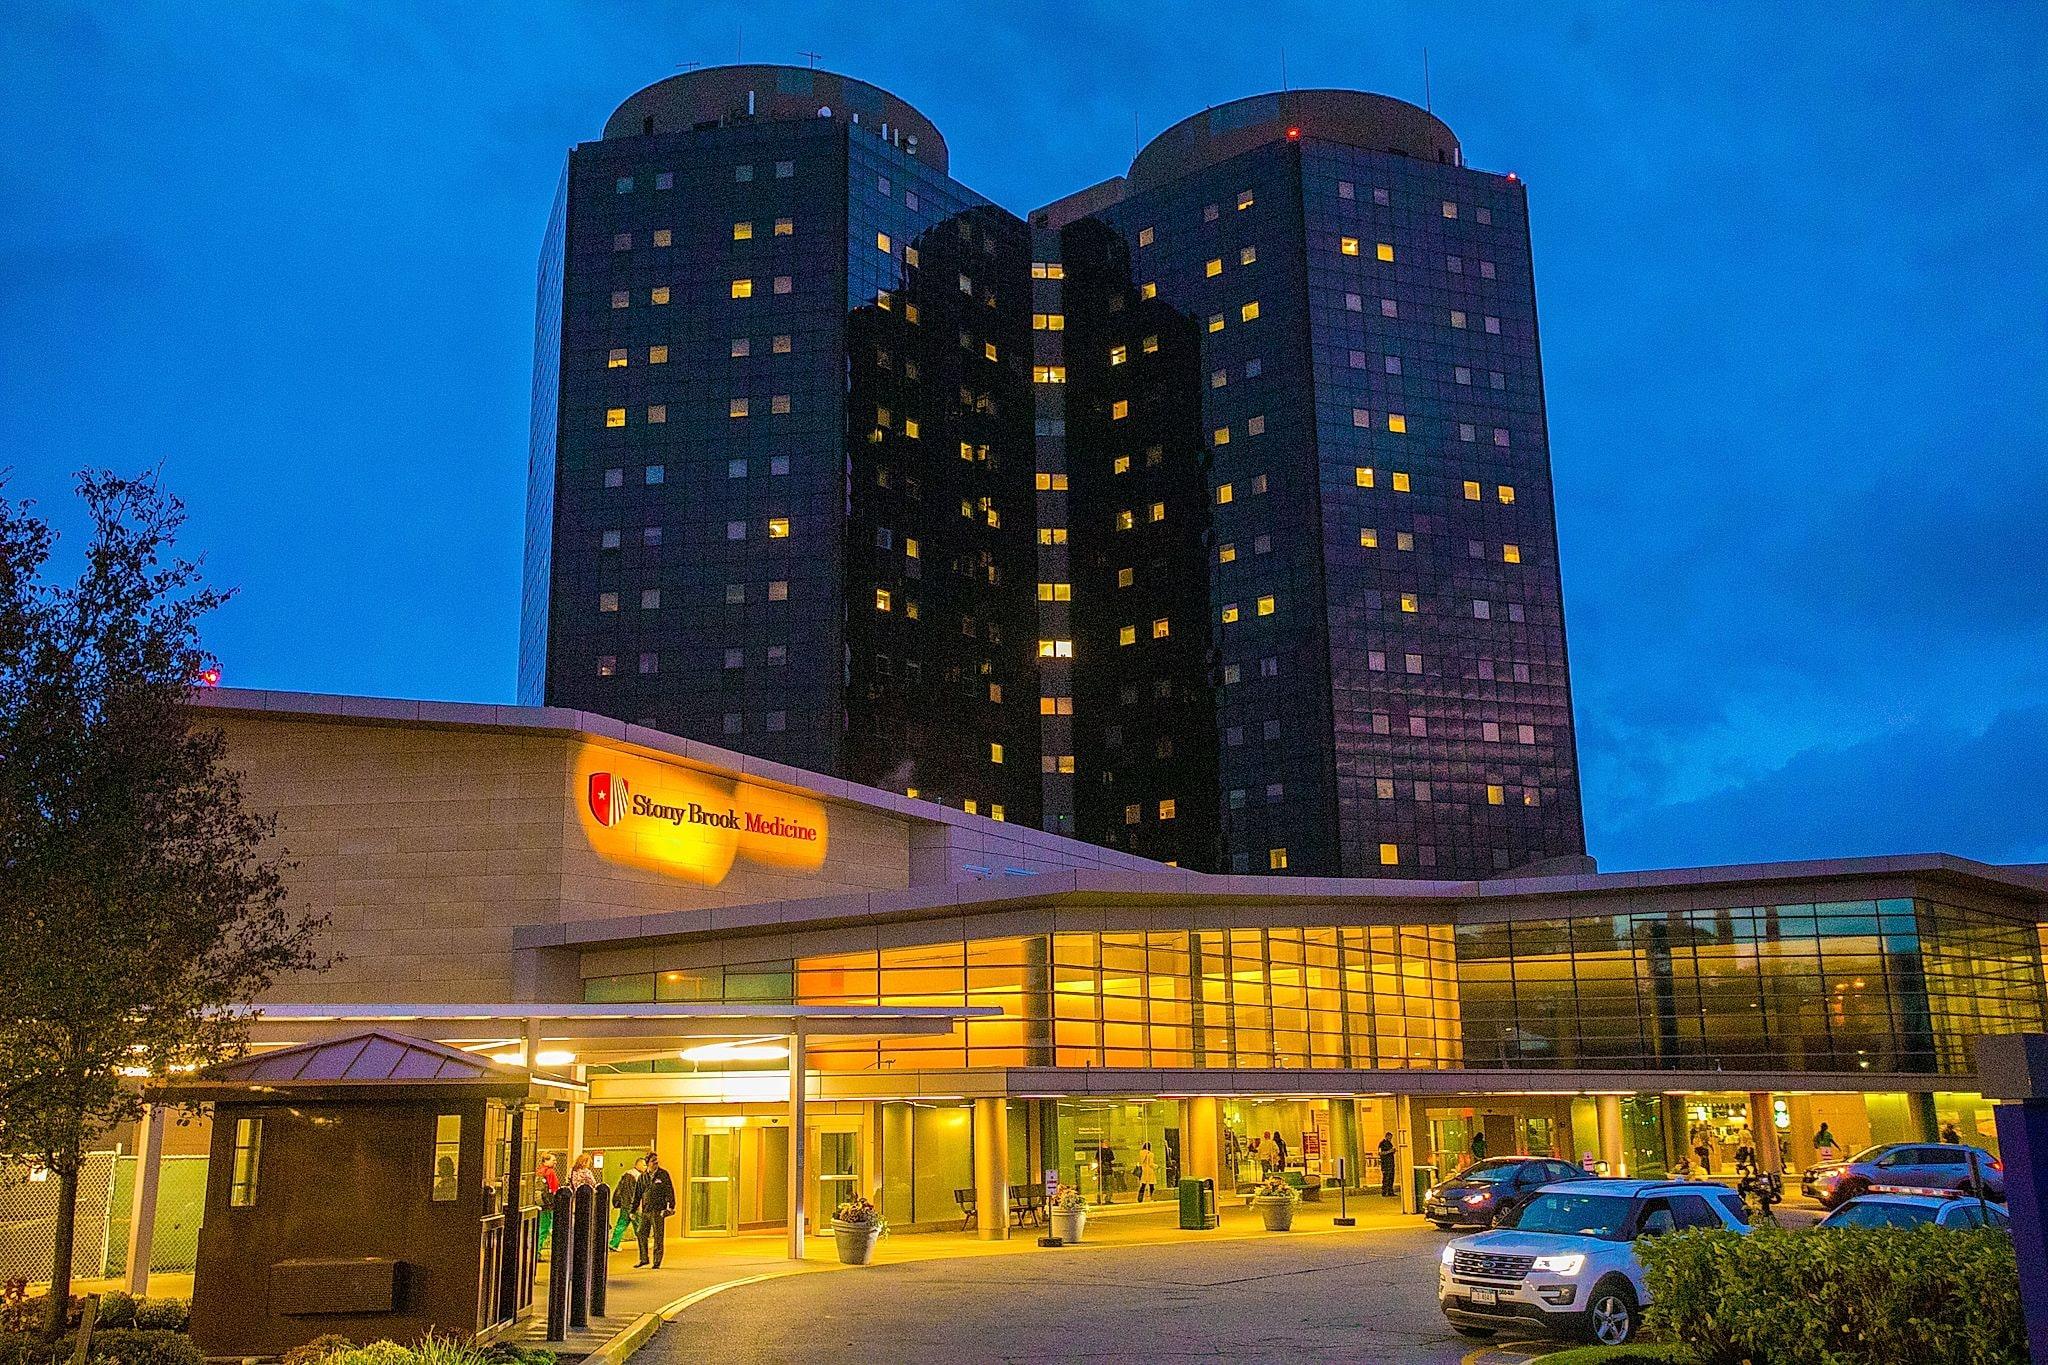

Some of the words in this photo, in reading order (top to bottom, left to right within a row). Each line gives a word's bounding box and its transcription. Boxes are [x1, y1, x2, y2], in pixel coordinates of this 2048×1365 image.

[632, 794, 686, 826] Stony
[687, 802, 741, 830] Brook
[744, 811, 817, 841] Medicine
